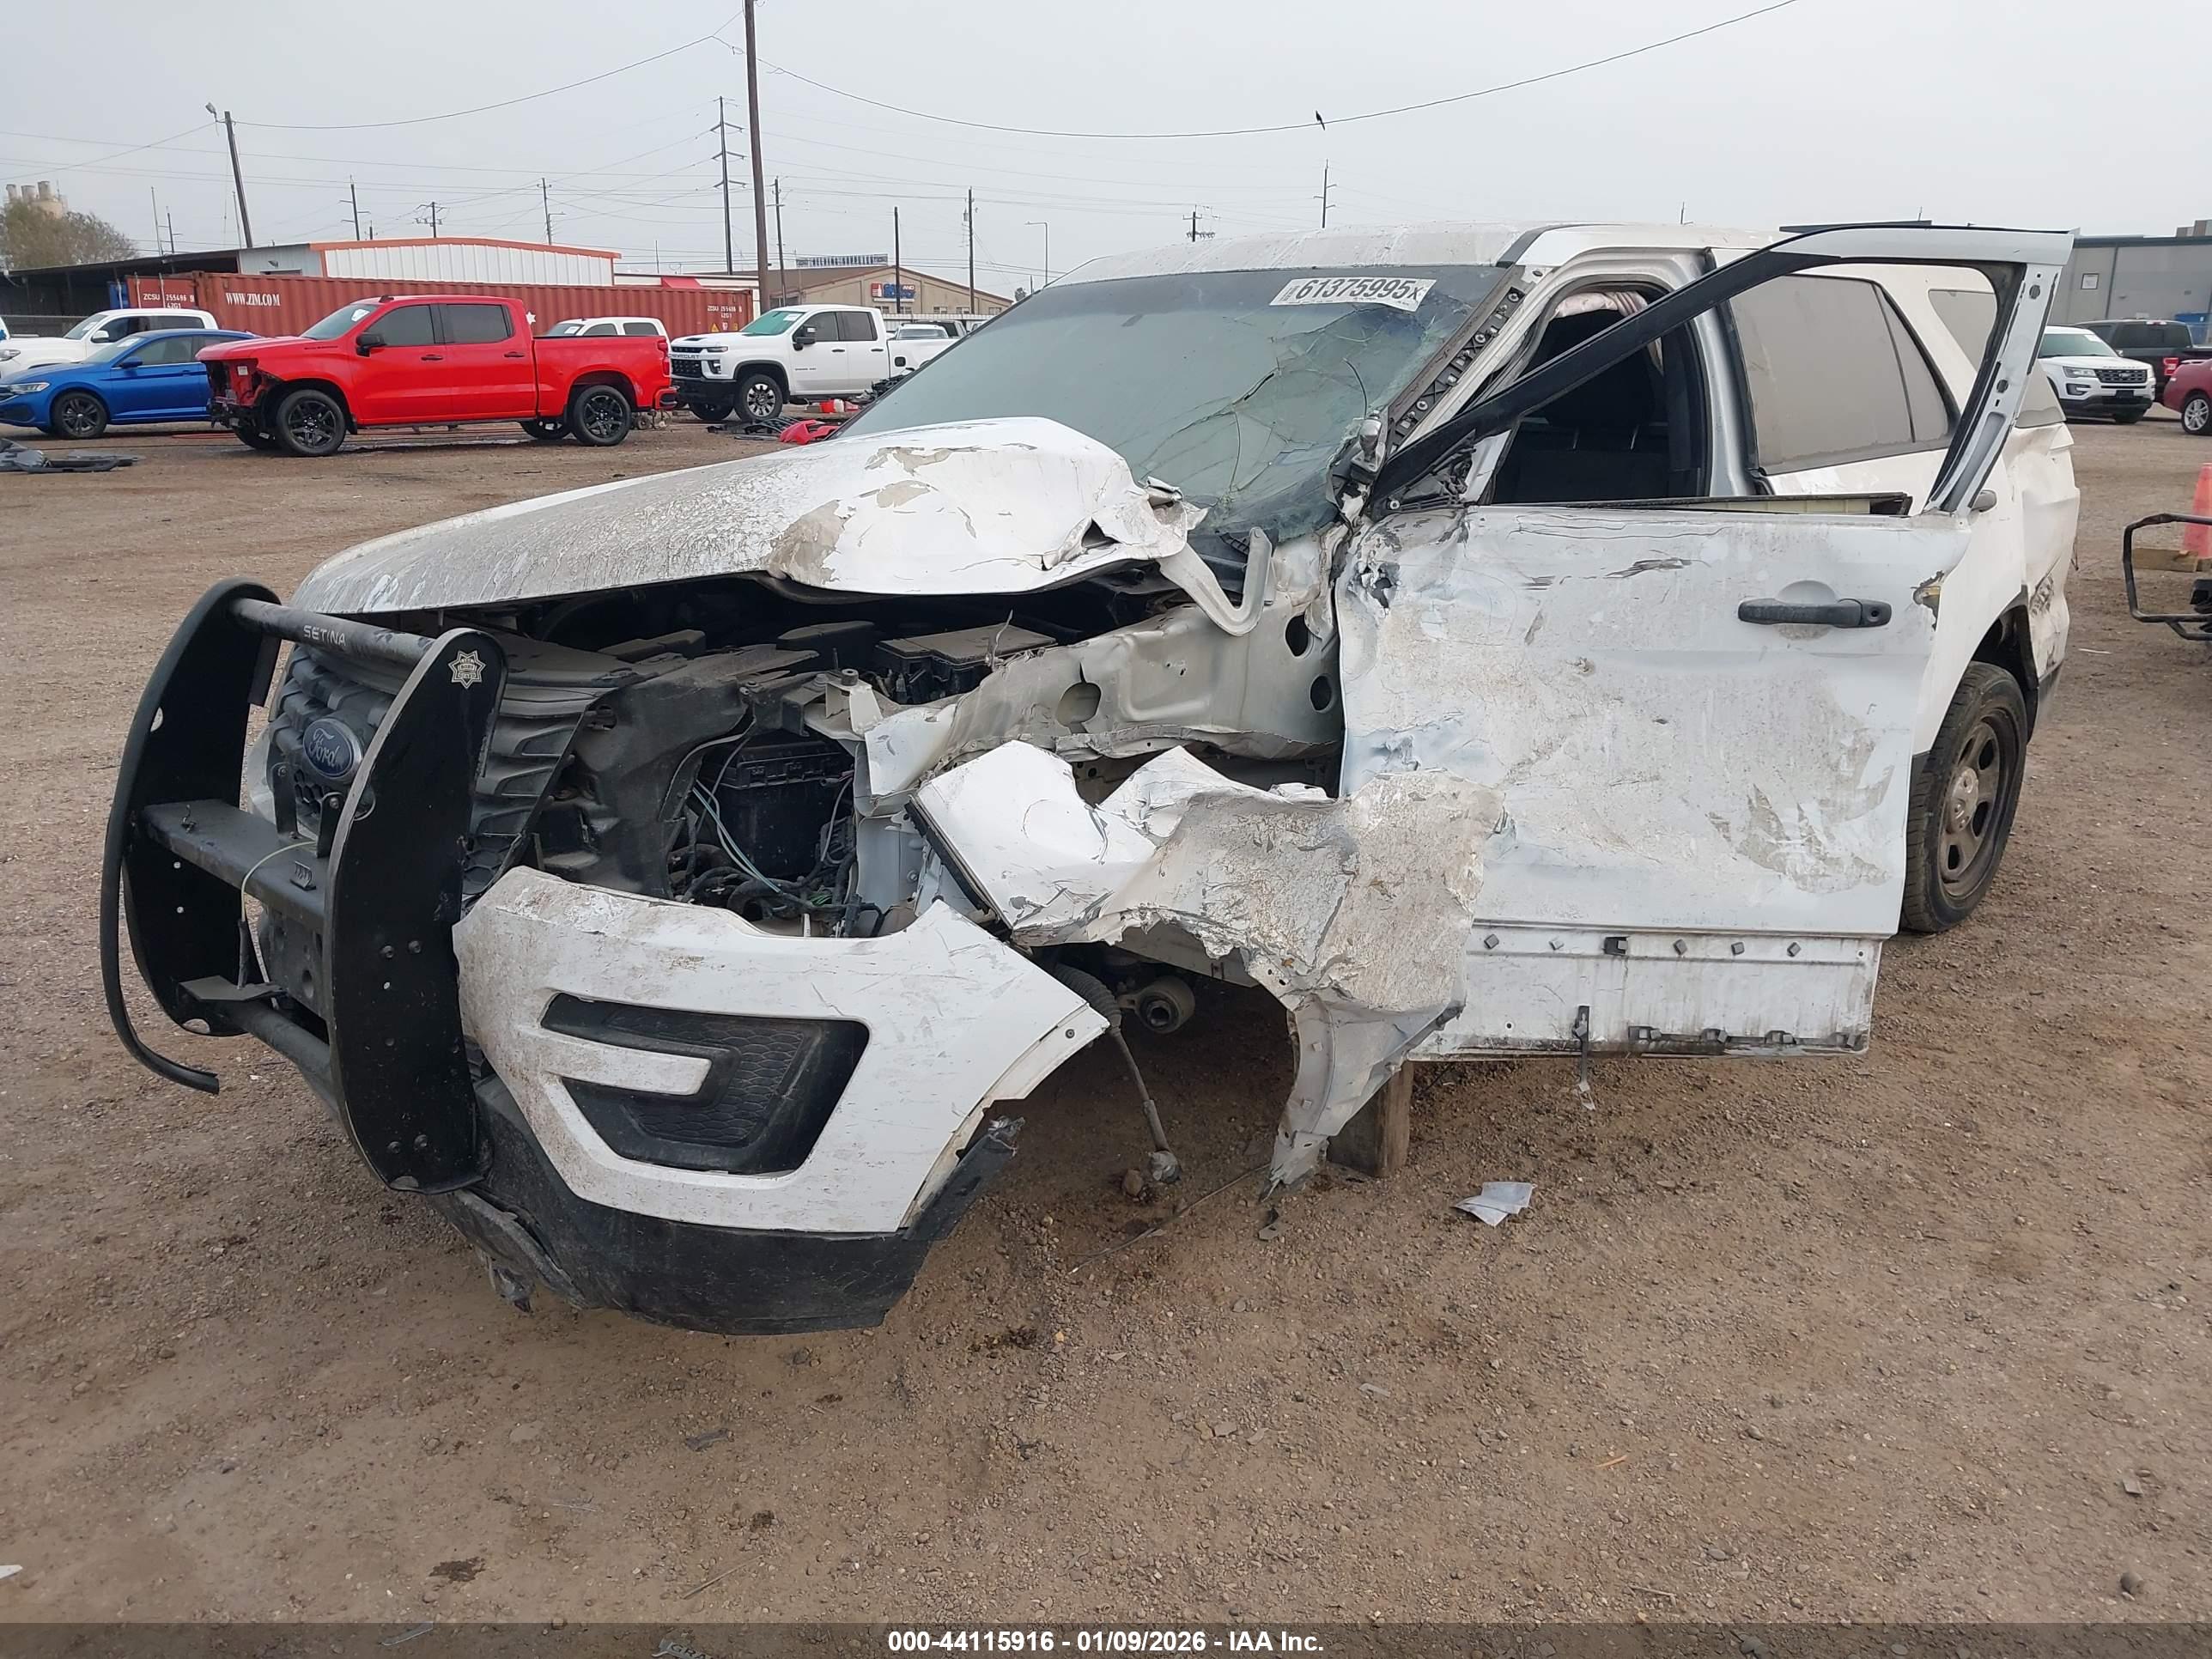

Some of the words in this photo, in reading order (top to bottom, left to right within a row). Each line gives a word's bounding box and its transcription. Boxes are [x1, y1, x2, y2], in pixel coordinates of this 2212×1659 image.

[225, 292, 281, 307] WWW.ZIM.COM
[303, 624, 347, 647] SETINA
[308, 727, 341, 768] Ford
